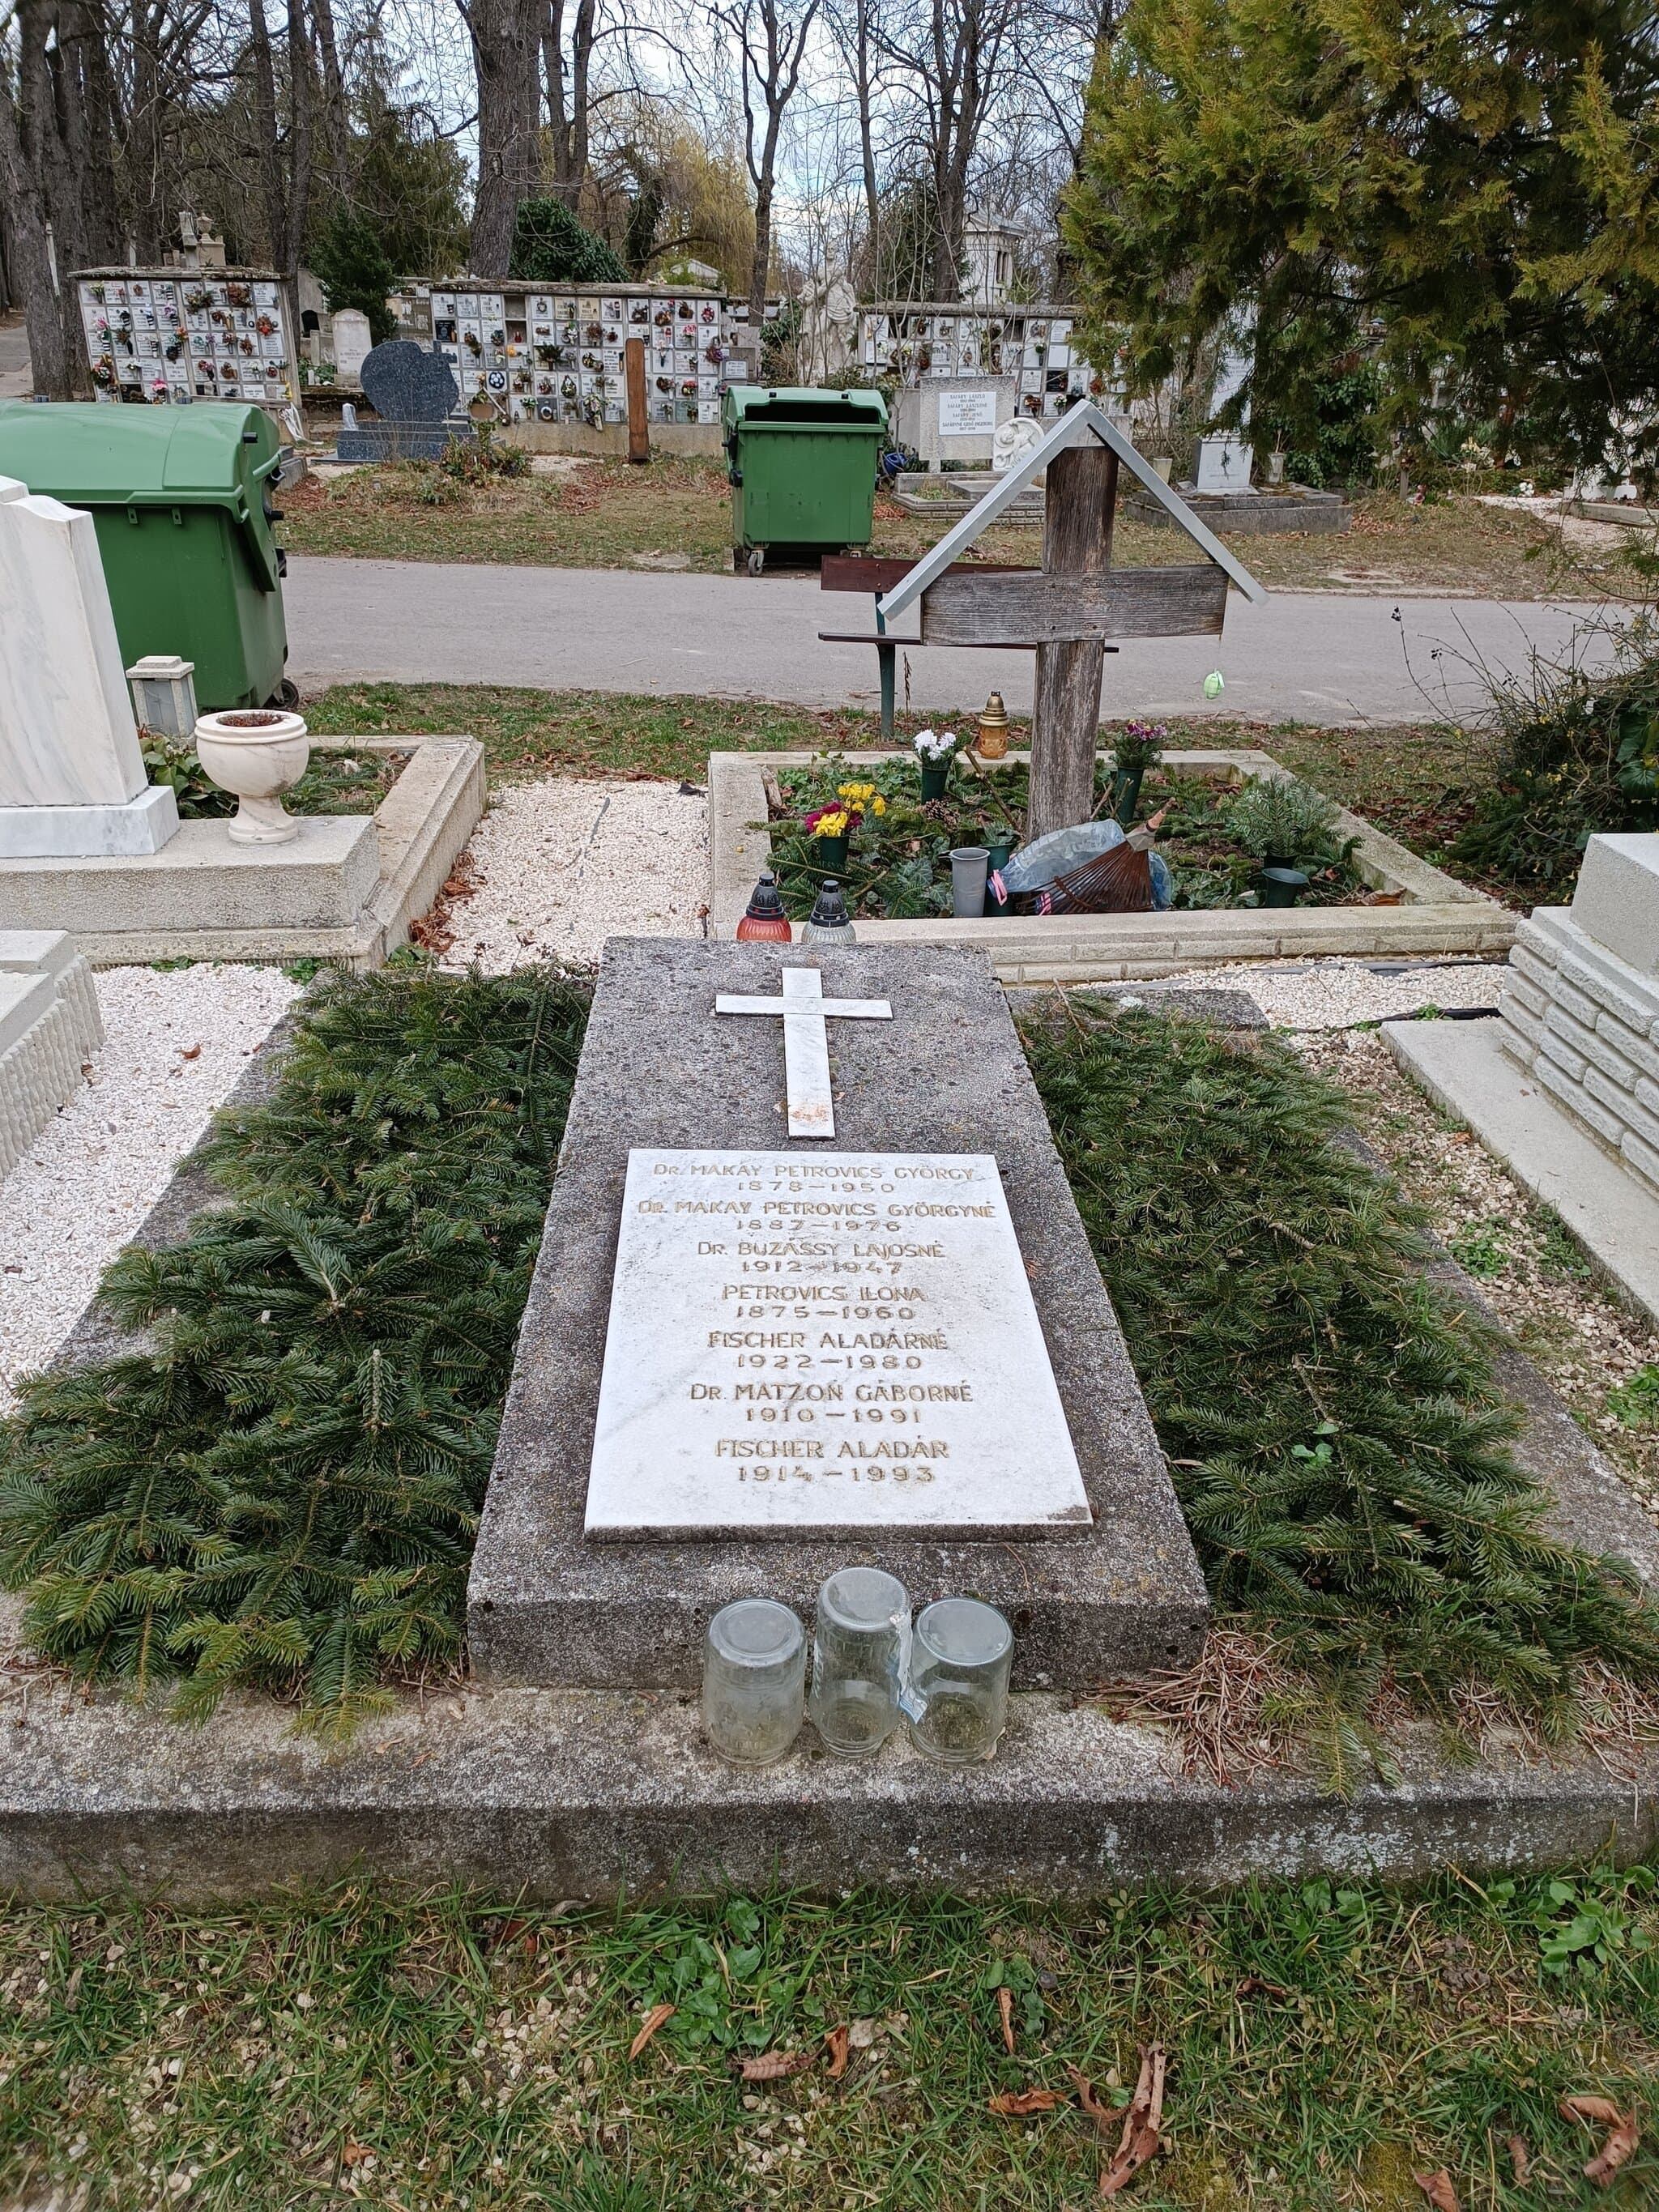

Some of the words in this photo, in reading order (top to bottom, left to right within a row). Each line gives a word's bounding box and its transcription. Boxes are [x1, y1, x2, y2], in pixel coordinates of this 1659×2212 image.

[690, 1165, 762, 1176] MAKAY
[774, 1166, 883, 1179] PETROVICS
[893, 1166, 975, 1180] GYÖRGY
[674, 1201, 753, 1214] MAKAY
[763, 1202, 877, 1216] PETROVICS
[888, 1201, 996, 1218] GYÖRGYNÉ
[853, 1240, 946, 1260] LAJOSNÉ
[723, 1285, 847, 1302] PETROVICS
[859, 1285, 928, 1302] ILONA
[707, 1331, 805, 1349] FISCHER
[820, 1328, 949, 1350] ALADÁRNÉ
[855, 1379, 974, 1403] GÁBORNÉ
[714, 1438, 825, 1458] FISCHER
[837, 1435, 950, 1459] ALADÁR
